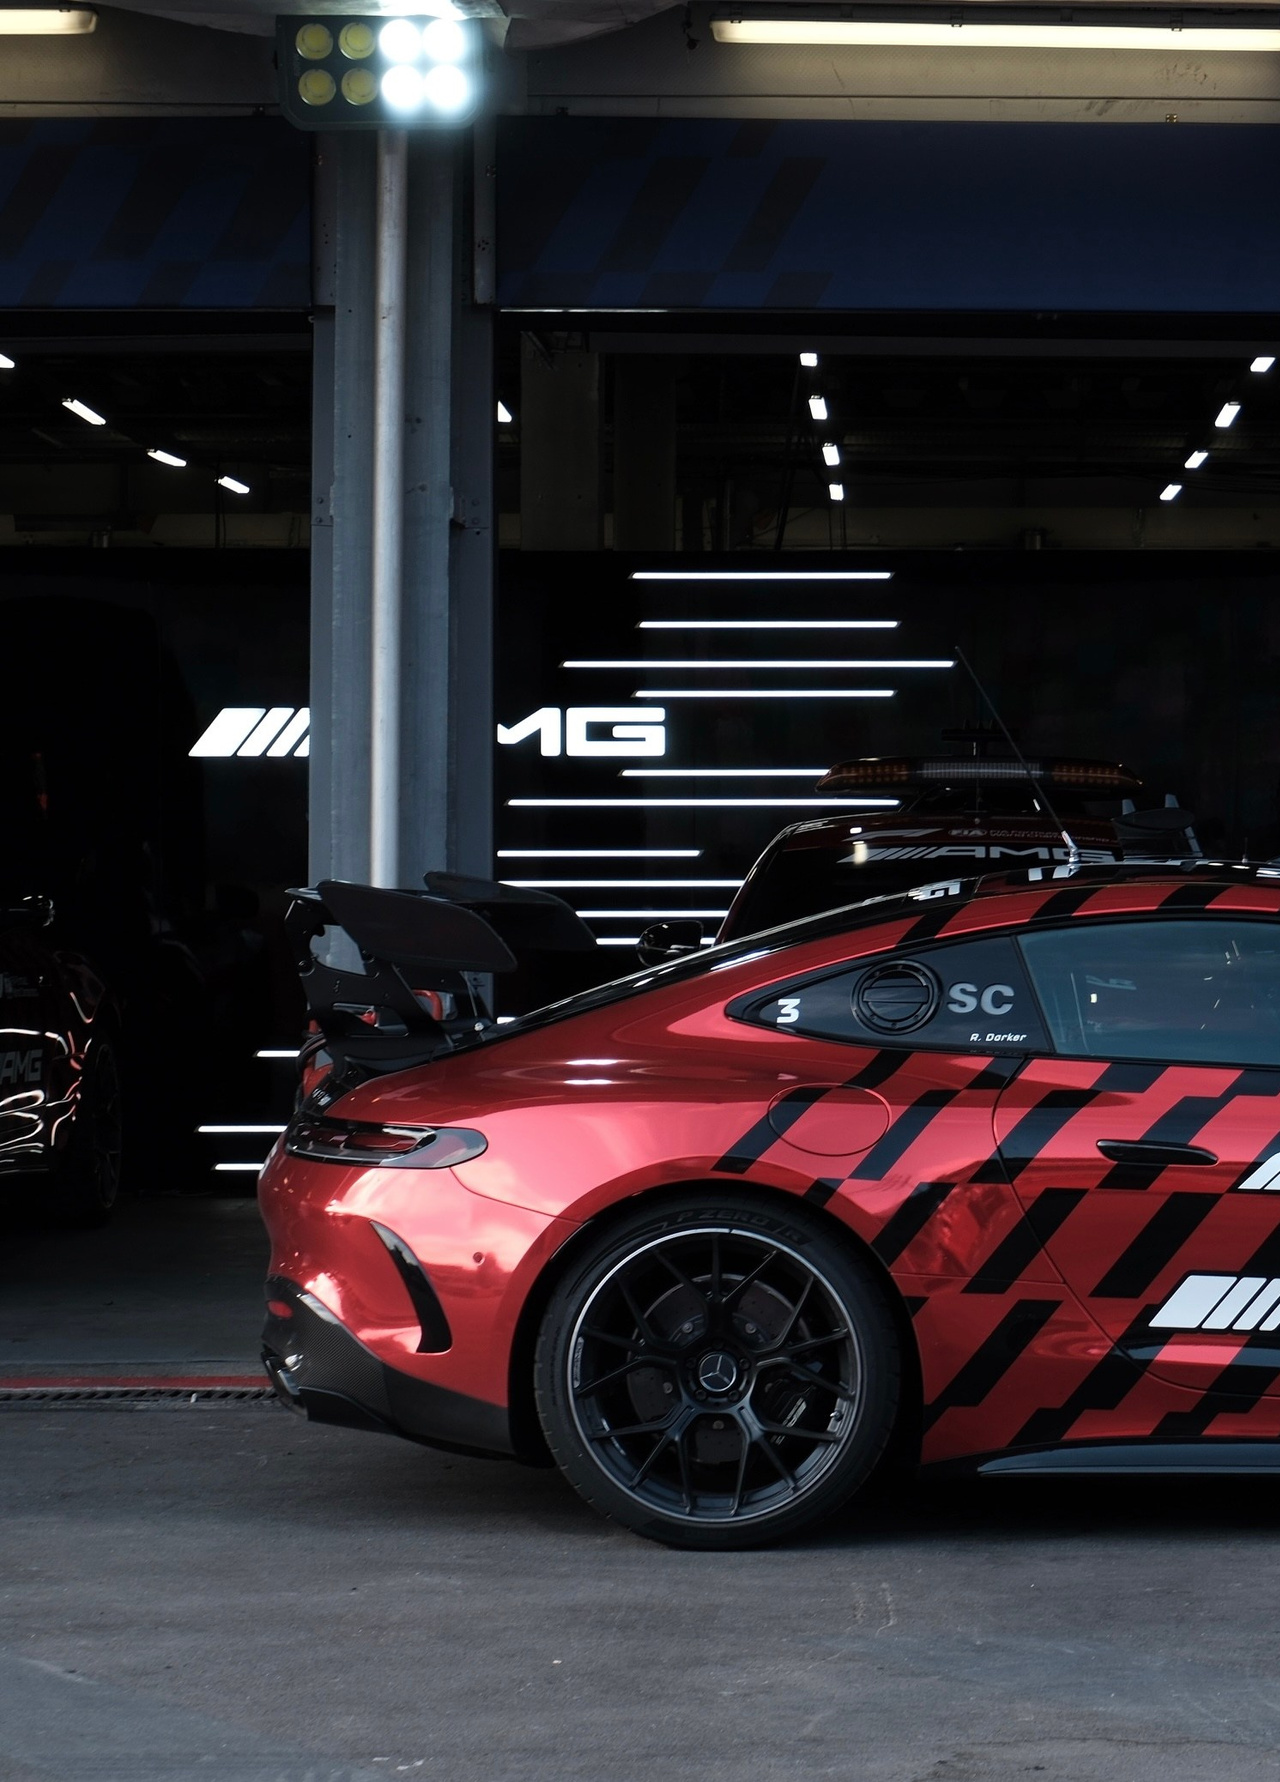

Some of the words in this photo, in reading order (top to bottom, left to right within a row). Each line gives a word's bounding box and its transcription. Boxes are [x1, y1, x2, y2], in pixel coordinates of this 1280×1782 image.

[497, 706, 667, 757] MG
[776, 999, 801, 1024] 3
[947, 982, 1015, 1015] SC
[969, 1033, 982, 1042] R.
[985, 1033, 1027, 1042] Darker
